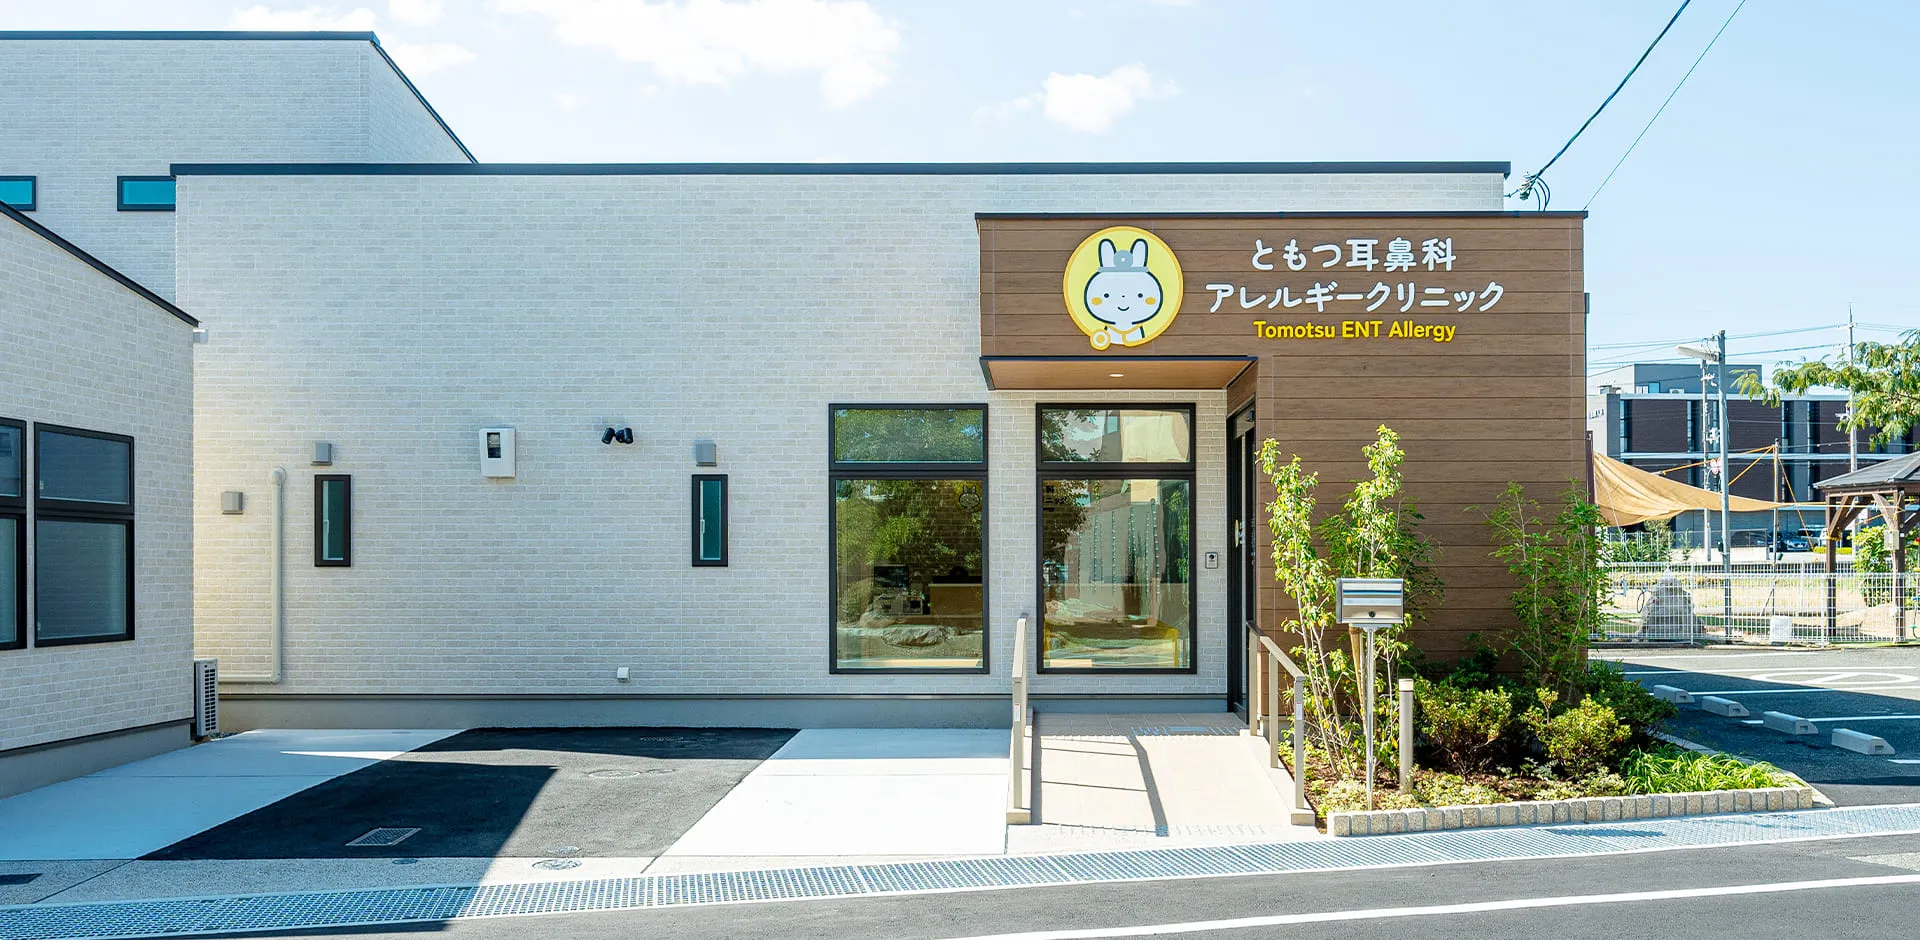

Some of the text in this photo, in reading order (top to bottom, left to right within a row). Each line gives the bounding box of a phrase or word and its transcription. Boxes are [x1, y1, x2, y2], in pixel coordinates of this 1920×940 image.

[1252, 237, 1457, 273] ともつ耳鼻科
[1206, 281, 1504, 313] アレルギークリニック
[1254, 320, 1456, 343] Tomotsu ENT Allergy
